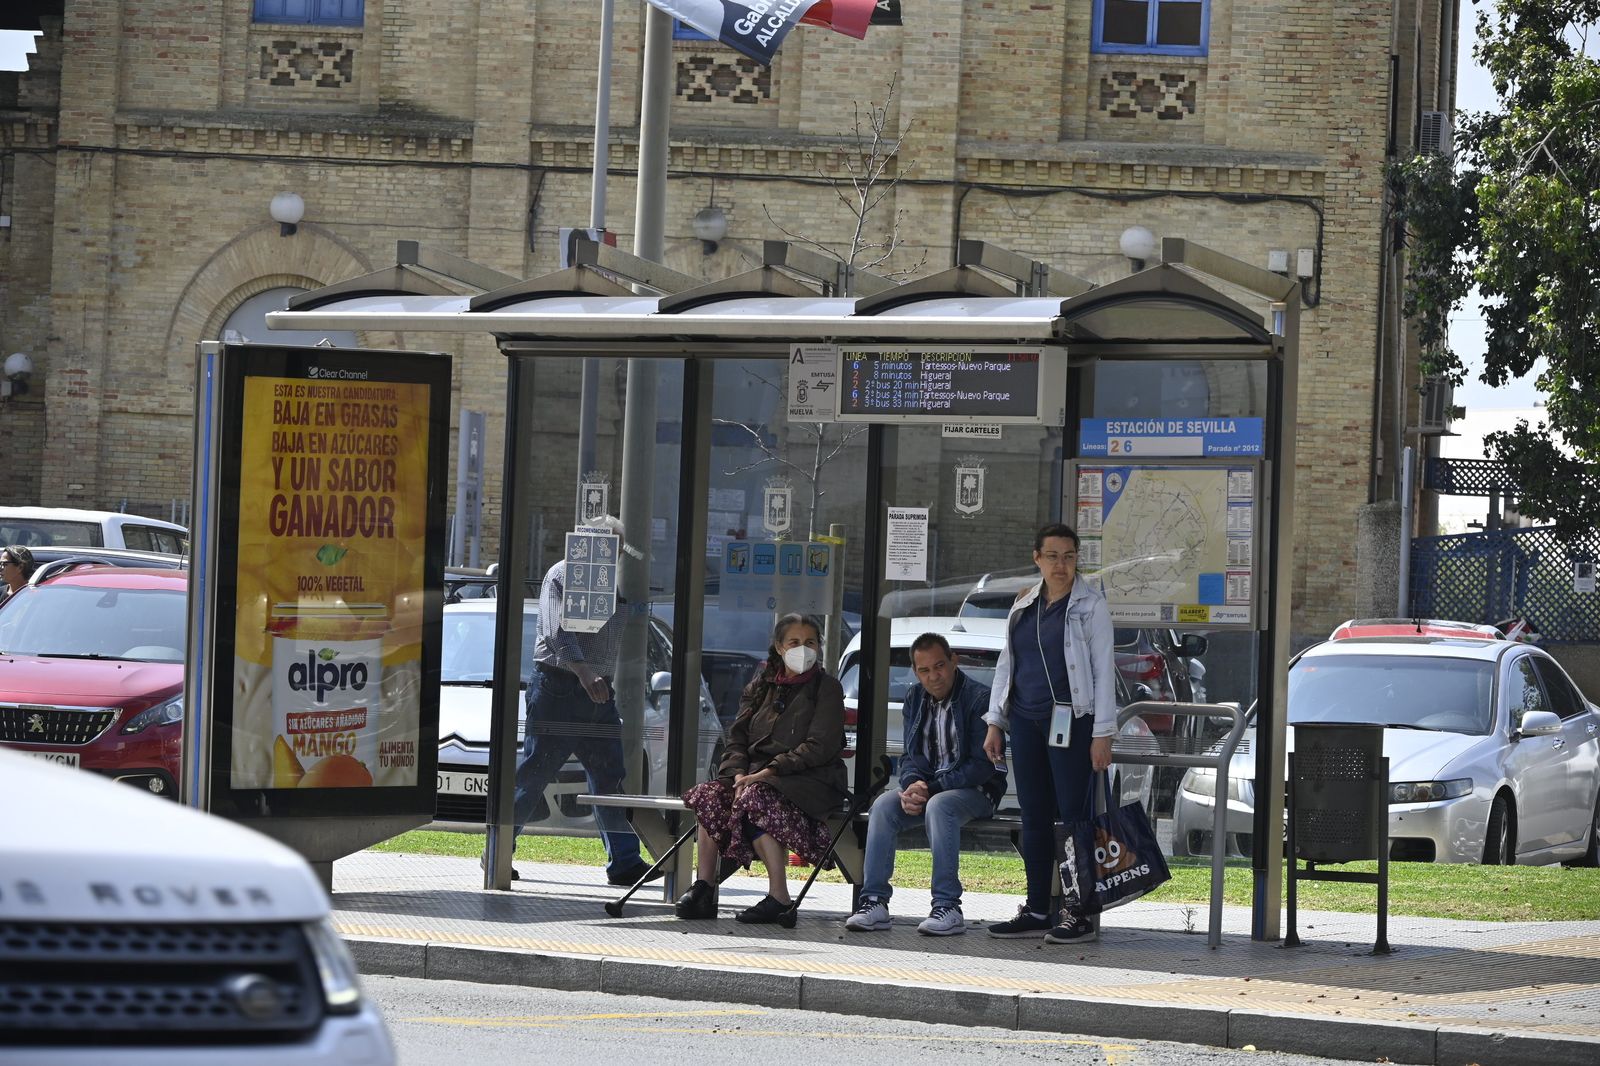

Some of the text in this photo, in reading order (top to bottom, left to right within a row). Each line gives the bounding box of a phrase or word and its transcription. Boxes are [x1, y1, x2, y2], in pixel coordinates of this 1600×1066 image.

[791, 348, 804, 364] A
[879, 352, 910, 361] TIEMPO
[852, 361, 1011, 372] 6 5 minutos Tartessos-Nuevo Parque
[319, 368, 368, 380] Clear Channel
[853, 370, 952, 381] 2 8 minutos Higueral
[274, 384, 293, 397] ESTA
[295, 385, 306, 398] ES
[307, 386, 340, 399] NUESTRA
[852, 380, 859, 388] 2
[876, 380, 890, 389] bus
[893, 380, 902, 389] 20
[905, 380, 919, 389] min
[920, 381, 951, 390] Higueral
[852, 390, 858, 398] 6
[876, 390, 890, 399] bus
[893, 390, 902, 399] 24
[905, 390, 919, 399] min
[920, 391, 982, 400] Tartessos-Nuevo
[983, 391, 1010, 401] Parque
[876, 399, 890, 408] bus
[893, 399, 902, 408] 33
[904, 399, 918, 408] min
[919, 400, 951, 410] Higueral
[273, 400, 398, 428] BAJA EN GRASAS
[790, 408, 814, 416] HUELVA
[1106, 419, 1236, 434] ESTACIÓN DE SEVILLA
[272, 429, 398, 456] BAJA EN AZÚCARES
[1110, 440, 1119, 453] 2
[1124, 440, 1132, 452] 6
[1243, 444, 1260, 452] 2012
[271, 456, 397, 493] Y UN SABOR
[269, 494, 396, 539] GANADOR
[297, 576, 365, 592] 100% VEGETAL
[288, 649, 368, 703] alpro
[288, 712, 367, 730] SIN AZÚCARES AÑADIDOS
[292, 732, 356, 757] MANGO
[379, 741, 414, 755] ALIMENTA
[379, 755, 414, 768] TU MUNDO
